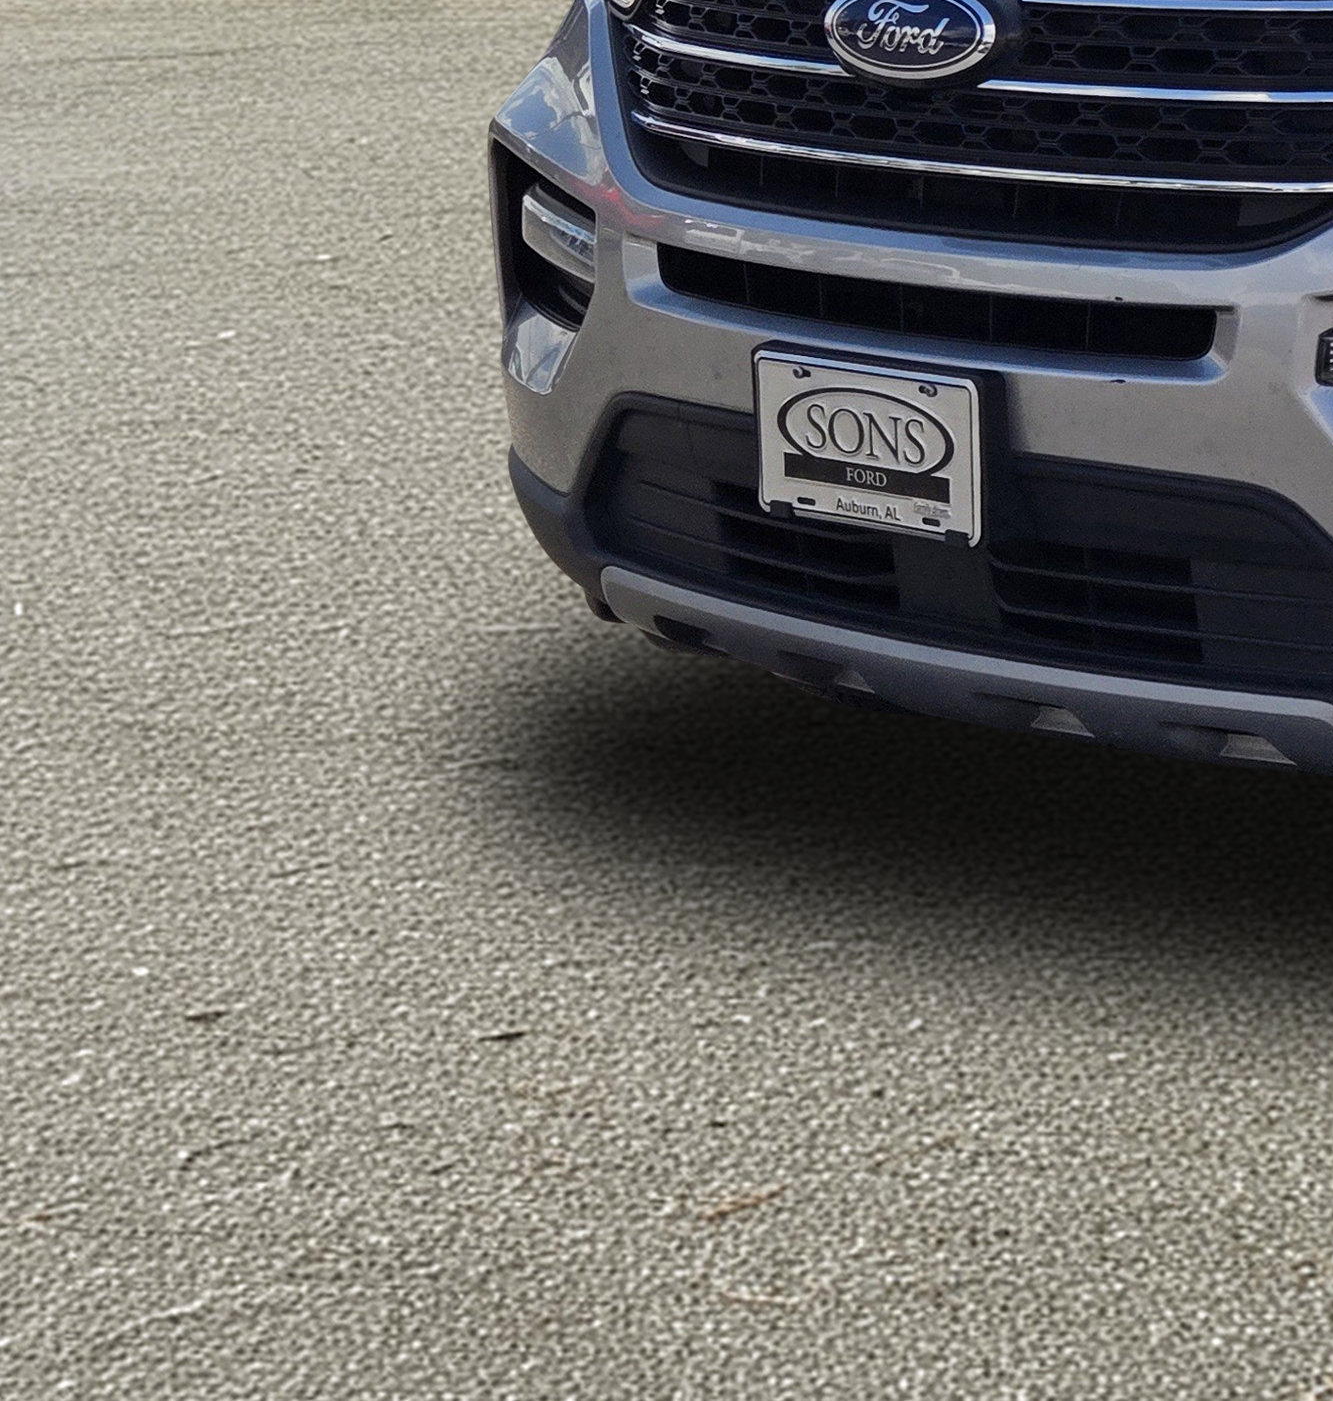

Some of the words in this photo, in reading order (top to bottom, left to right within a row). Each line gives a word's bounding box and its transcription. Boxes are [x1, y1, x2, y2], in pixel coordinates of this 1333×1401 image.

[805, 403, 926, 465] SONS
[845, 466, 888, 488] FORD
[835, 497, 882, 520] Auburn,
[884, 505, 901, 521] AL
